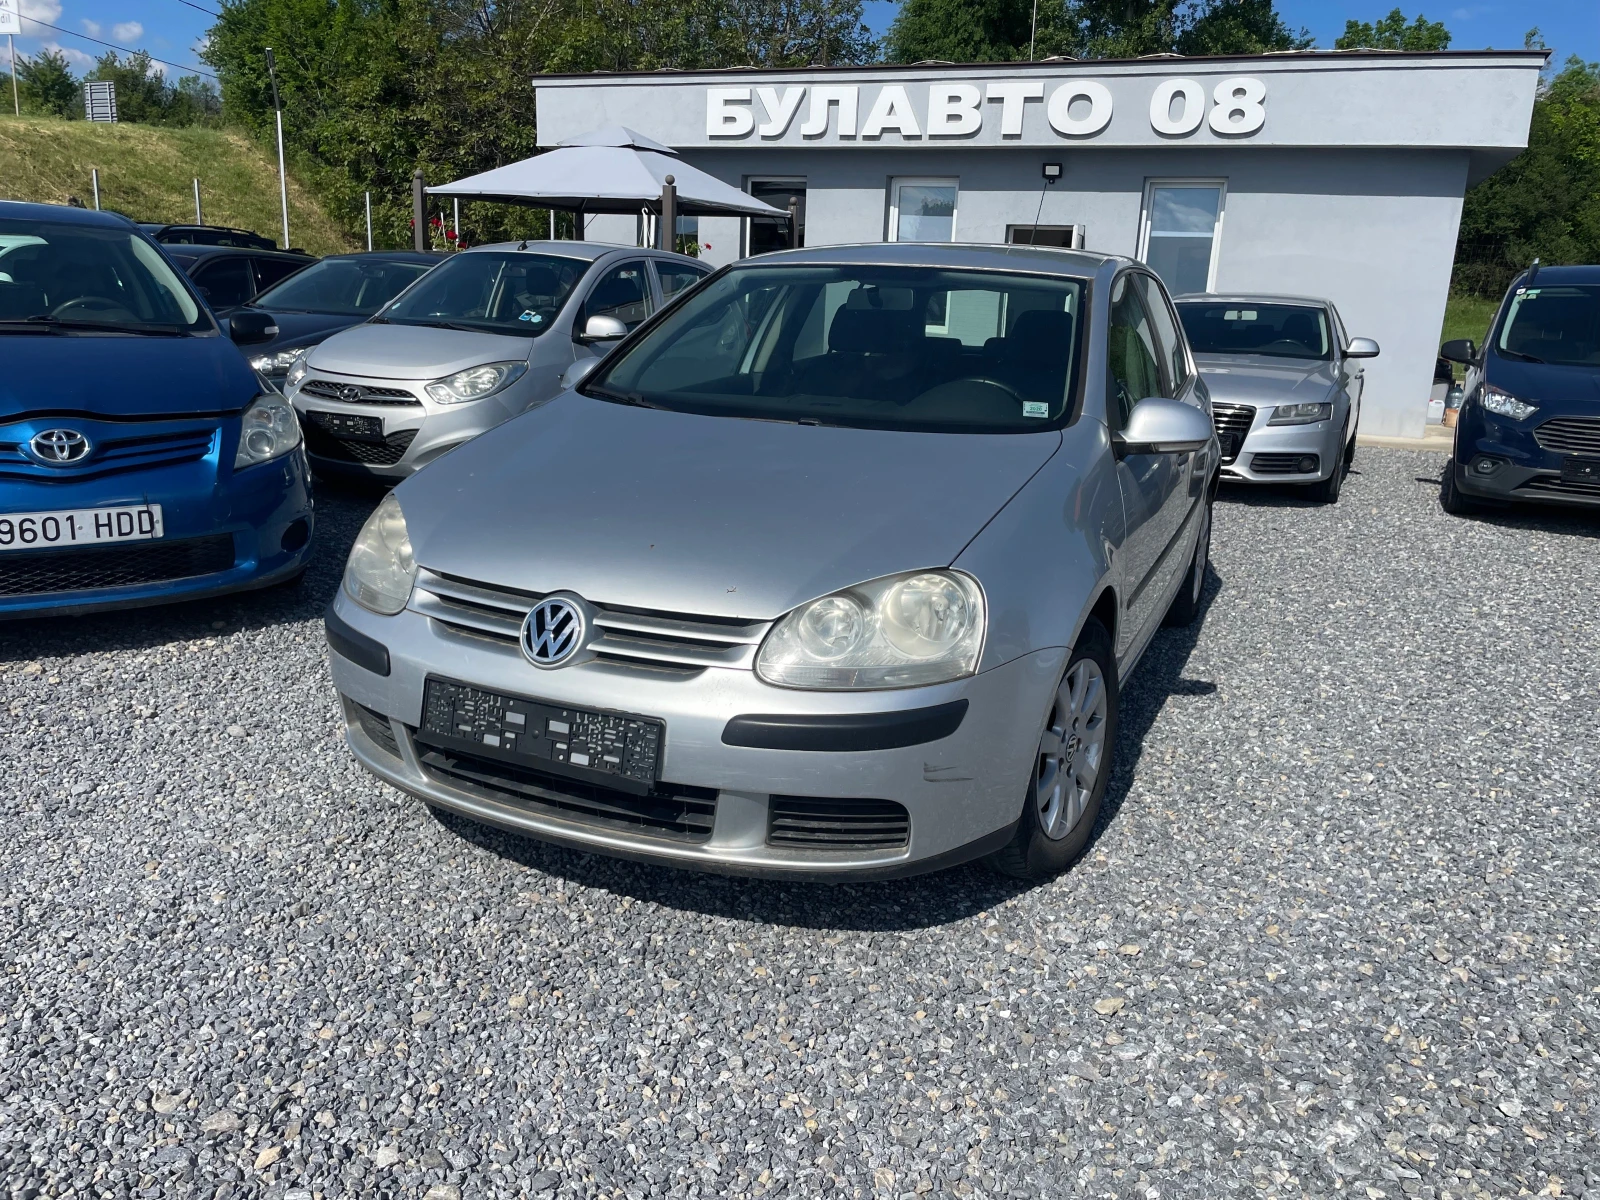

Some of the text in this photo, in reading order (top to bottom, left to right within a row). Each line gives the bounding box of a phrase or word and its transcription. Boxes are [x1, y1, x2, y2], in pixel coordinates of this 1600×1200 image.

[706, 77, 1266, 140] БУЛАВТО 08
[0, 509, 155, 545] 9601 HDD
